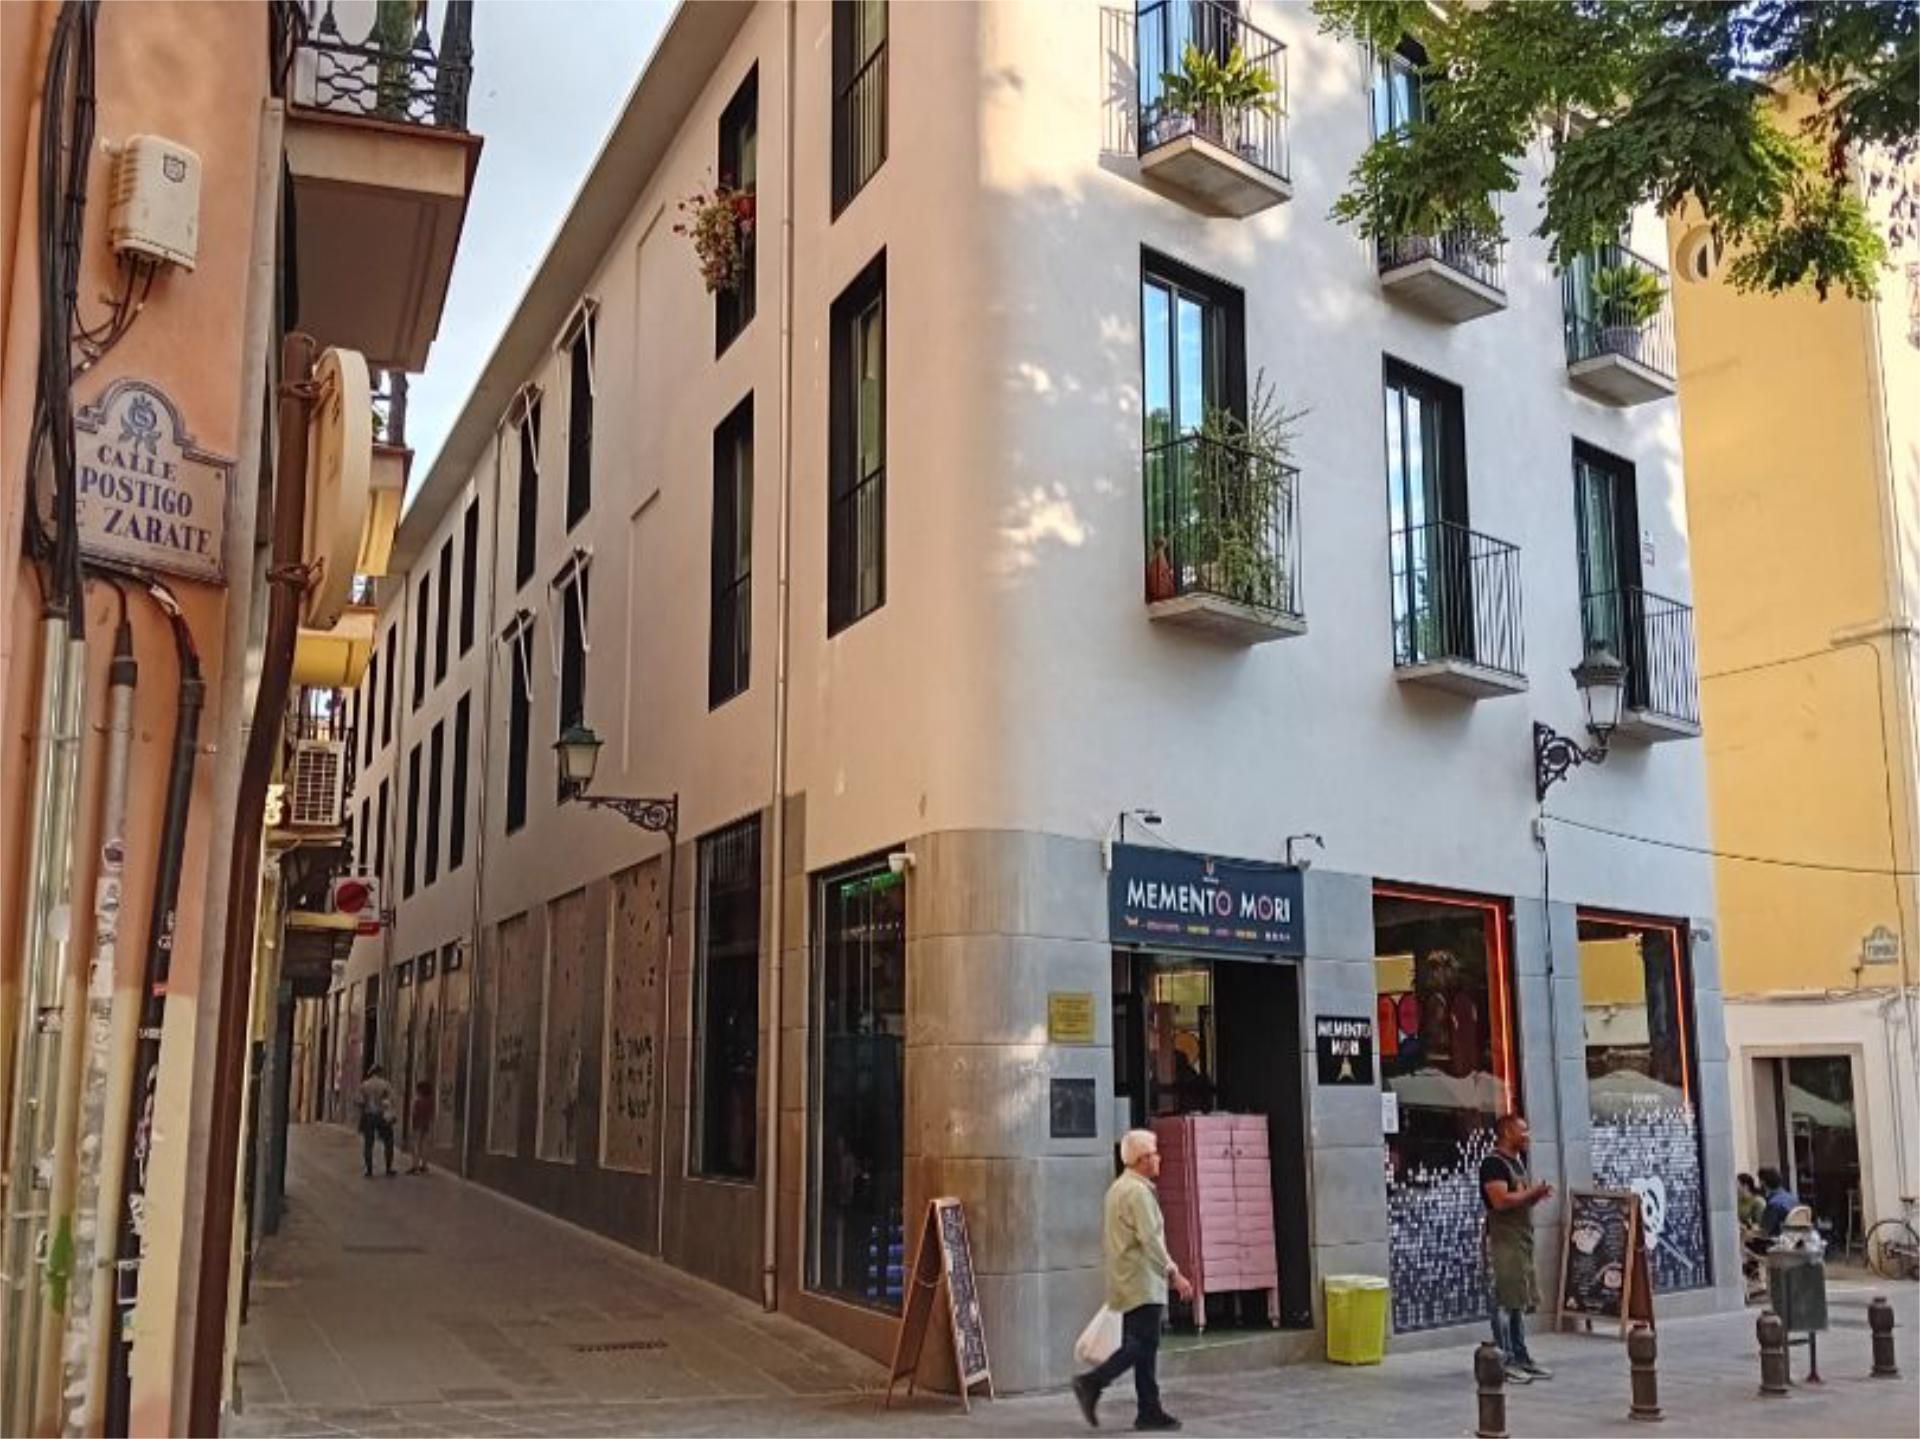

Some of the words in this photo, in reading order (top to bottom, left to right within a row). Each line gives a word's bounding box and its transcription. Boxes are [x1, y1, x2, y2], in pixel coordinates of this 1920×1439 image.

[97, 445, 177, 481] CALLE
[80, 466, 192, 518] POSTIGO
[104, 507, 212, 554] ZARATE
[1127, 877, 1232, 917] MEMENTO
[1240, 892, 1291, 924] MORI
[1317, 1020, 1373, 1039] MEMENTO
[1331, 1038, 1360, 1056] MORI
